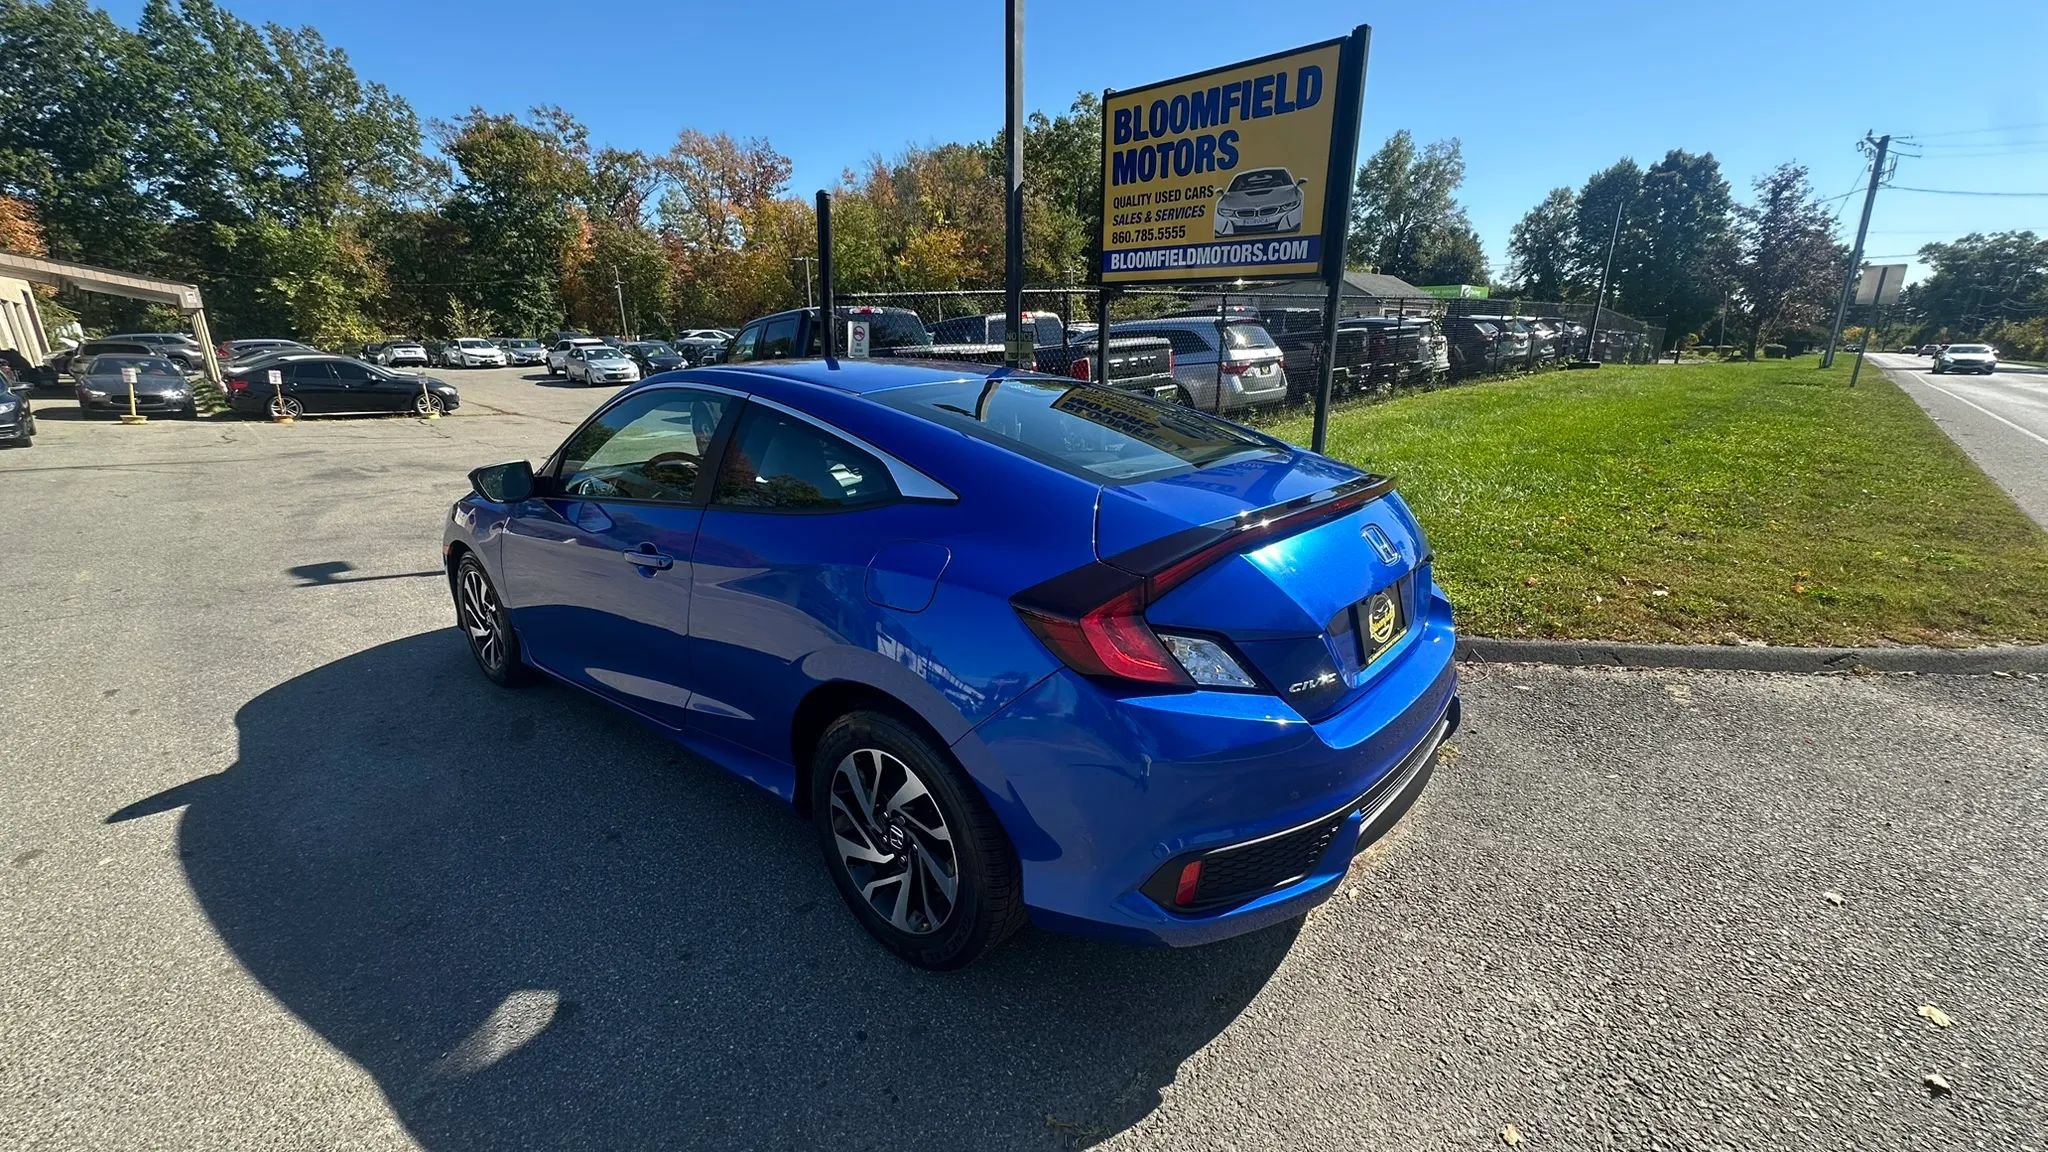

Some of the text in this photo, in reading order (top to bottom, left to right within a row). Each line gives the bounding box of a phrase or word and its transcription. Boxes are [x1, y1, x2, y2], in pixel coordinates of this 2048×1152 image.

[1113, 65, 1323, 146] BLOOMFIELD
[1112, 129, 1239, 187] MOTORS
[1113, 184, 1214, 209] QUALITY USED CARS
[1112, 204, 1206, 227] SALES & SERVICES
[1112, 225, 1186, 245] 860.785.5555
[1111, 240, 1309, 270] BLOOMFIELDMOTORS.COM
[1006, 332, 1033, 342] NOICE
